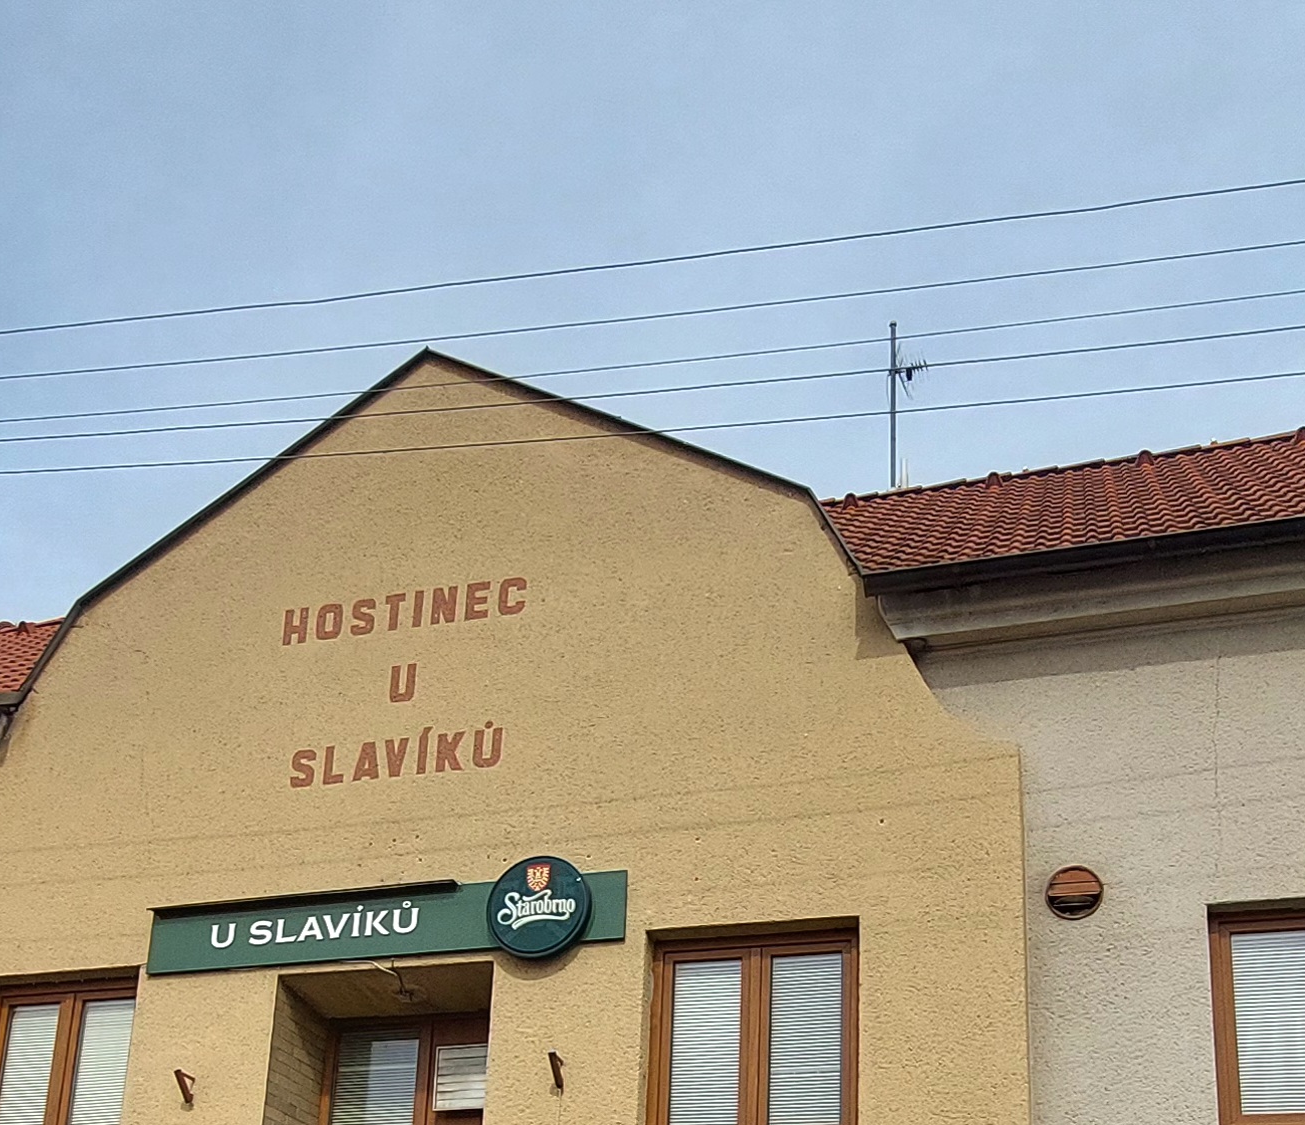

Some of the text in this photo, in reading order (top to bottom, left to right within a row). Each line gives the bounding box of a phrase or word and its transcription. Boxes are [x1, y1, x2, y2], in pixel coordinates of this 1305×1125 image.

[282, 577, 528, 646] HOSTINEC
[389, 662, 417, 703] U
[289, 720, 503, 788] SLAVÍKŮ
[210, 900, 420, 949] U SLAVÍKŮ
[497, 889, 576, 930] Starobrno
